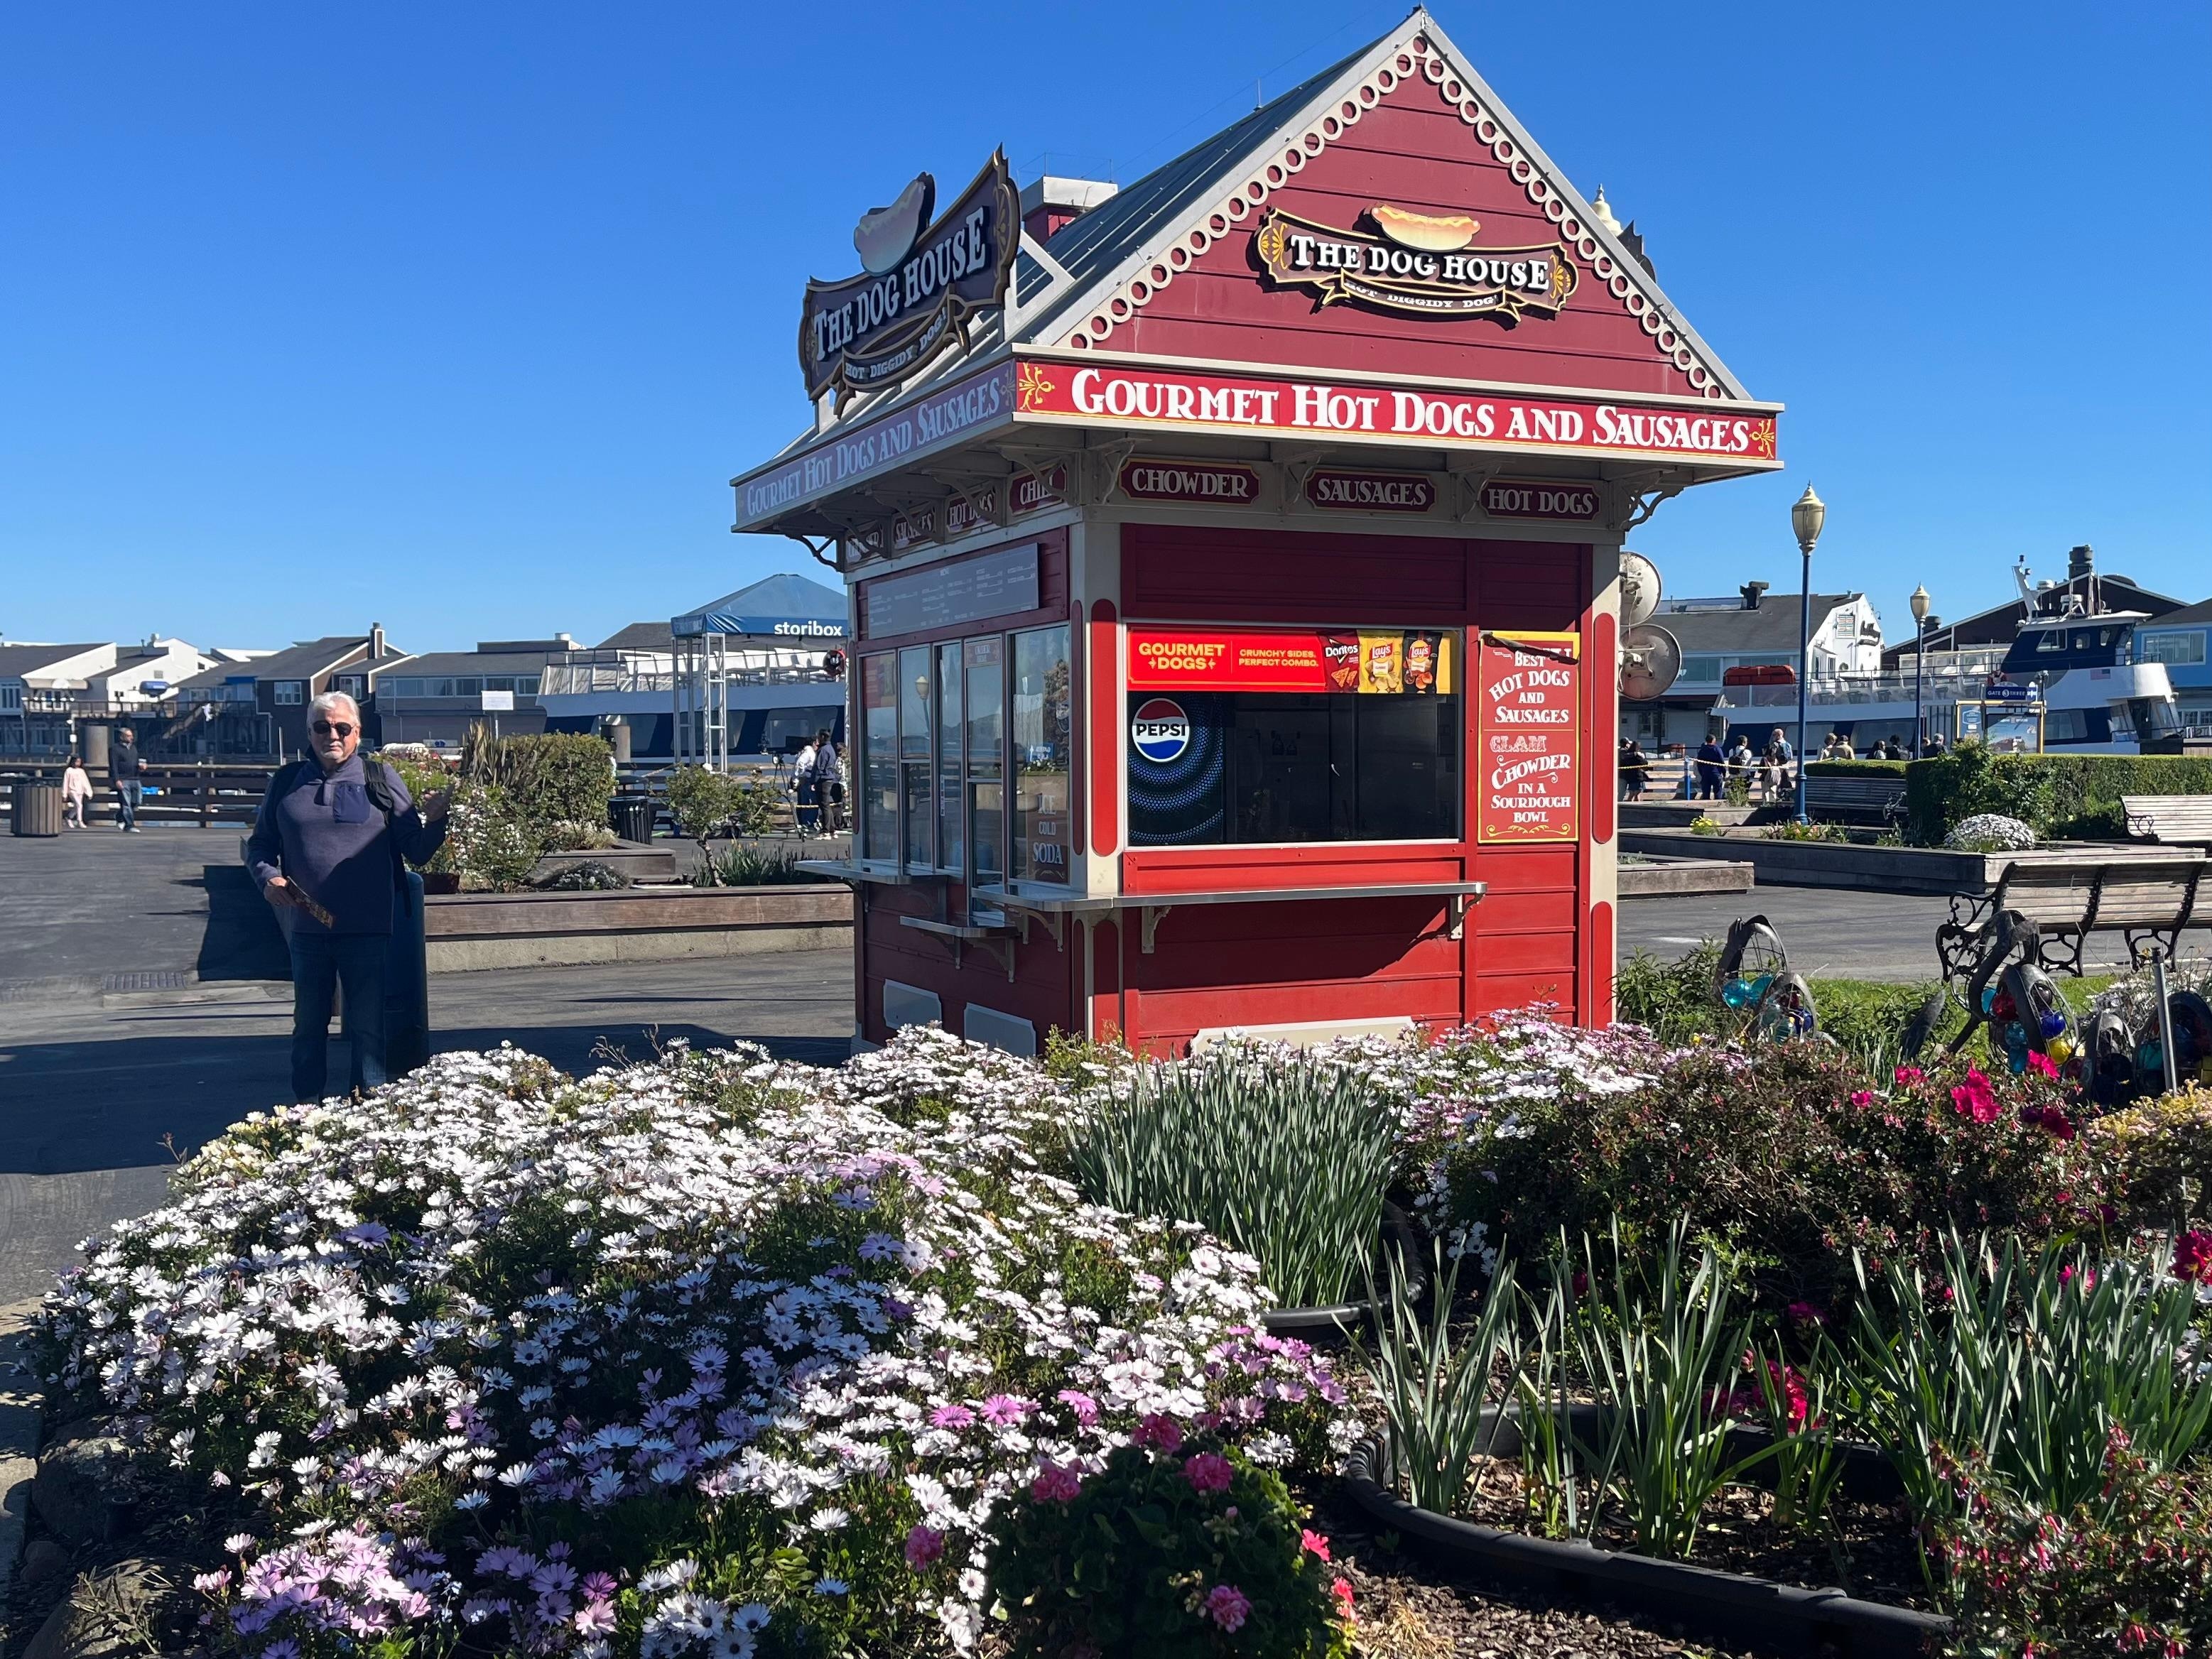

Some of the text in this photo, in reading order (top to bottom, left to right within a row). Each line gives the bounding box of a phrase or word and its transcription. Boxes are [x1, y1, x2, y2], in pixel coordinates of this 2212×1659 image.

[1291, 234, 1549, 291] THE DOG HOUSE
[814, 207, 986, 361] THE DOG HOUSE
[1344, 281, 1378, 298] HOT
[1387, 293, 1453, 308] DIGGIDY
[845, 361, 864, 380] HOT
[870, 347, 915, 378] DIGGIDY
[1070, 368, 1750, 452] GOURMET HOT DOGS AND SAUSAGES
[747, 376, 1000, 516] GOURMET HOT DOGS AND SAUSAGES
[1132, 467, 1249, 498] CHOWDER
[1316, 477, 1426, 506] SAUSAGES
[1487, 486, 1593, 515] HOT DOGS
[949, 503, 967, 526] HOT
[774, 620, 842, 637] storibox
[1138, 642, 1226, 657] GOURMET
[1239, 648, 1317, 658] CRUNCHY SIDES.
[1325, 644, 1359, 658] Doritos
[1372, 643, 1392, 659] Lay's
[1411, 646, 1431, 659] Lay's
[1514, 650, 1546, 667] BEST
[1157, 657, 1207, 670] DOGS
[1238, 658, 1319, 667] PERFECT COMBO.
[1489, 670, 1570, 702] HOT DOGS
[1518, 692, 1544, 704] AND
[1495, 705, 1569, 724] SAUSAGES
[1137, 722, 1186, 737] PEPSI
[1489, 735, 1547, 753] CLAM
[1492, 754, 1571, 790] CHOWDER
[1517, 783, 1546, 794] IN A
[1038, 794, 1056, 815] ICE
[1491, 795, 1571, 809] SOURDOUGH
[1513, 812, 1549, 823] BOWL
[1039, 821, 1056, 836] COLD
[1033, 842, 1063, 866] SODA
